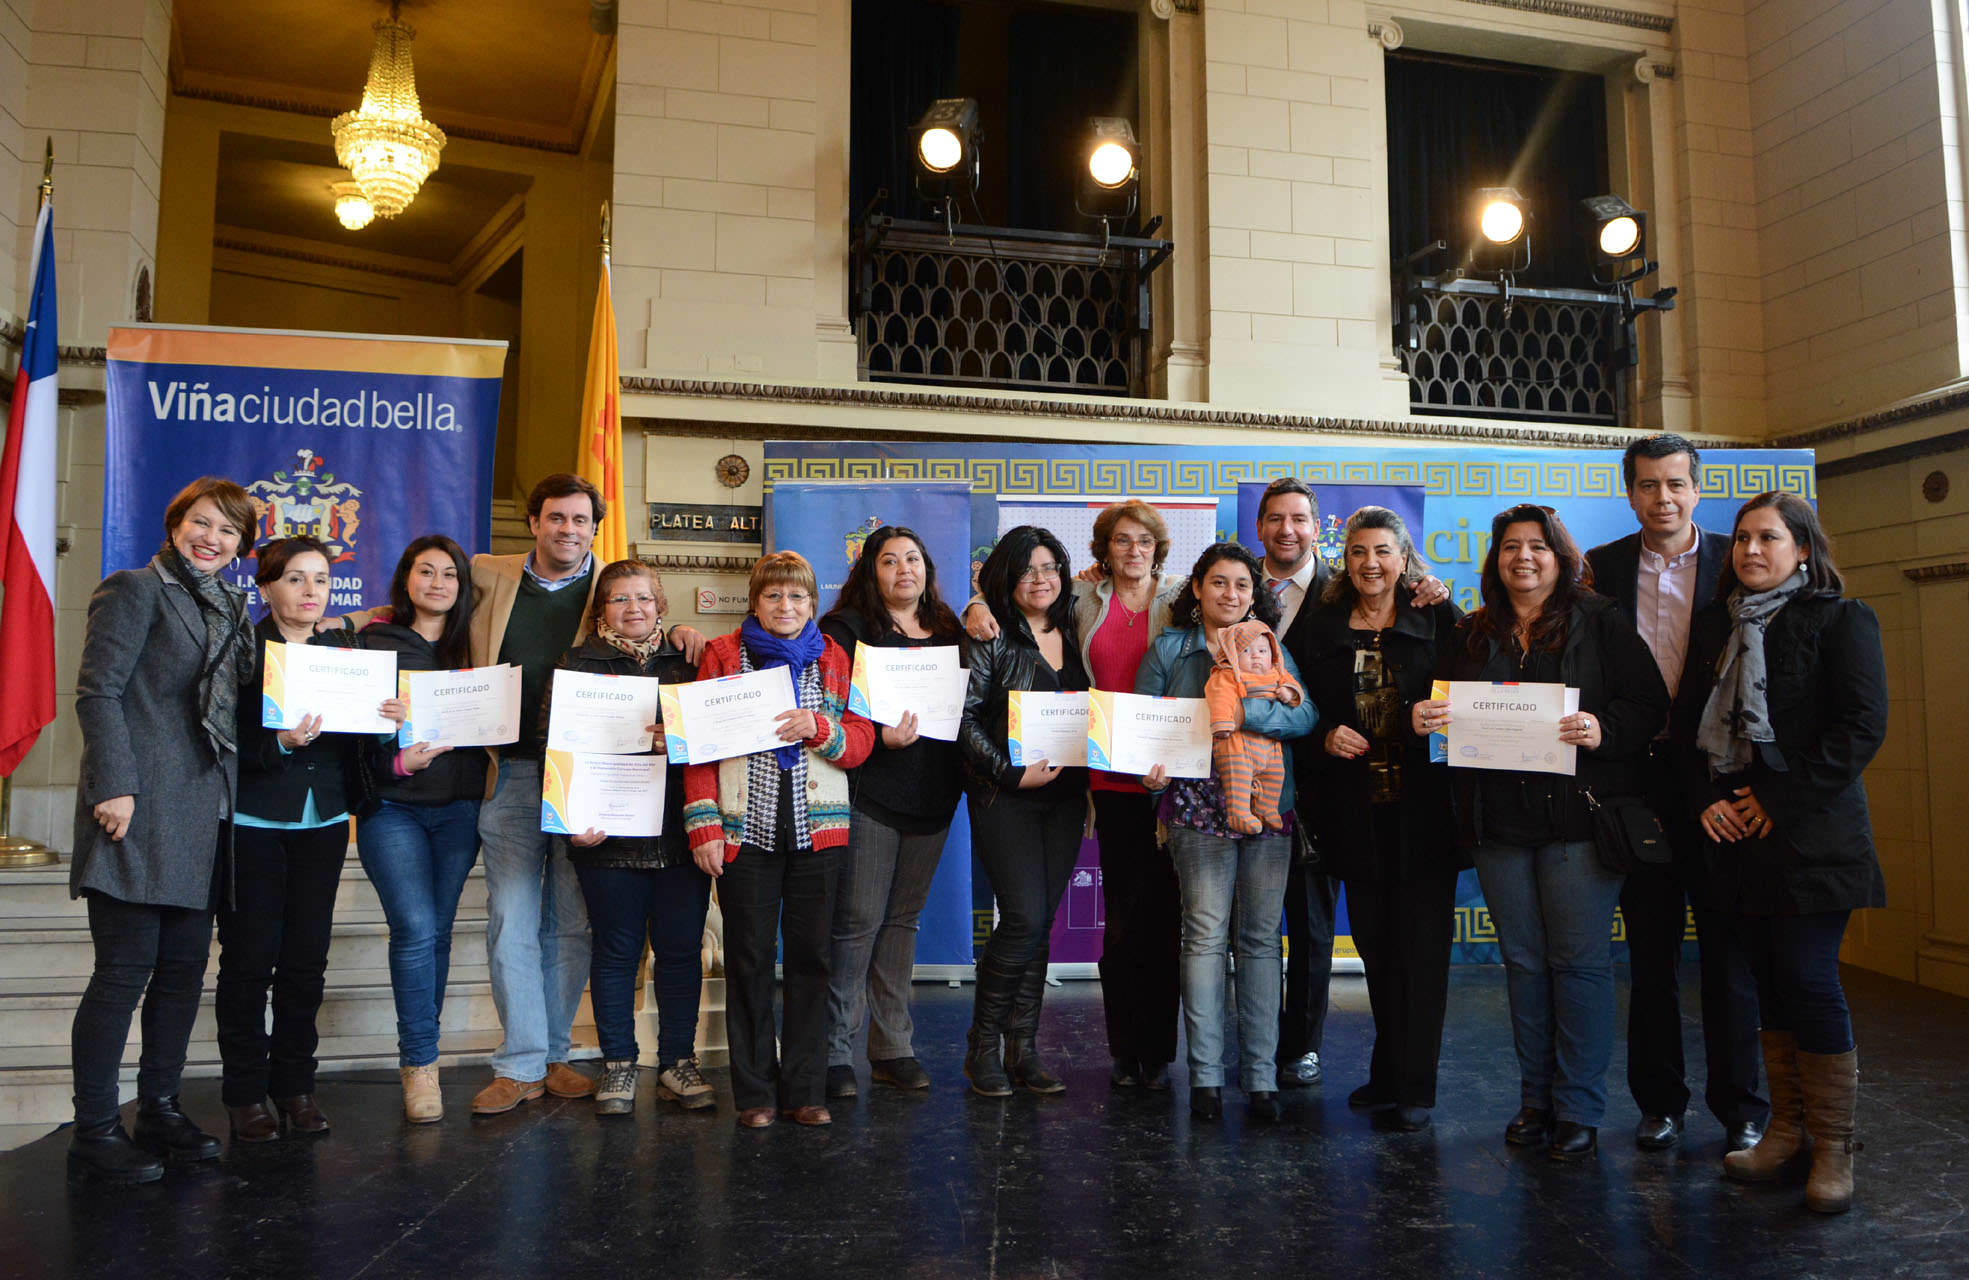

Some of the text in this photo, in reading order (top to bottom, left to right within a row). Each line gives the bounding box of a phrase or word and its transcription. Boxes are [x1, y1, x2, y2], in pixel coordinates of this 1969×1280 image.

[650, 513, 761, 530] PLATEA ALT
[330, 593, 362, 606] MAR
[309, 664, 369, 677] CERTIFICADO
[885, 664, 938, 672] CERTIFICADO
[433, 684, 490, 697] CERTIFICADO
[576, 690, 634, 702] CERTIFICADO
[704, 690, 762, 707] CERTIFICADO
[1473, 701, 1537, 712] CERTIFICADO
[1135, 712, 1192, 724] CERTIFICADO
